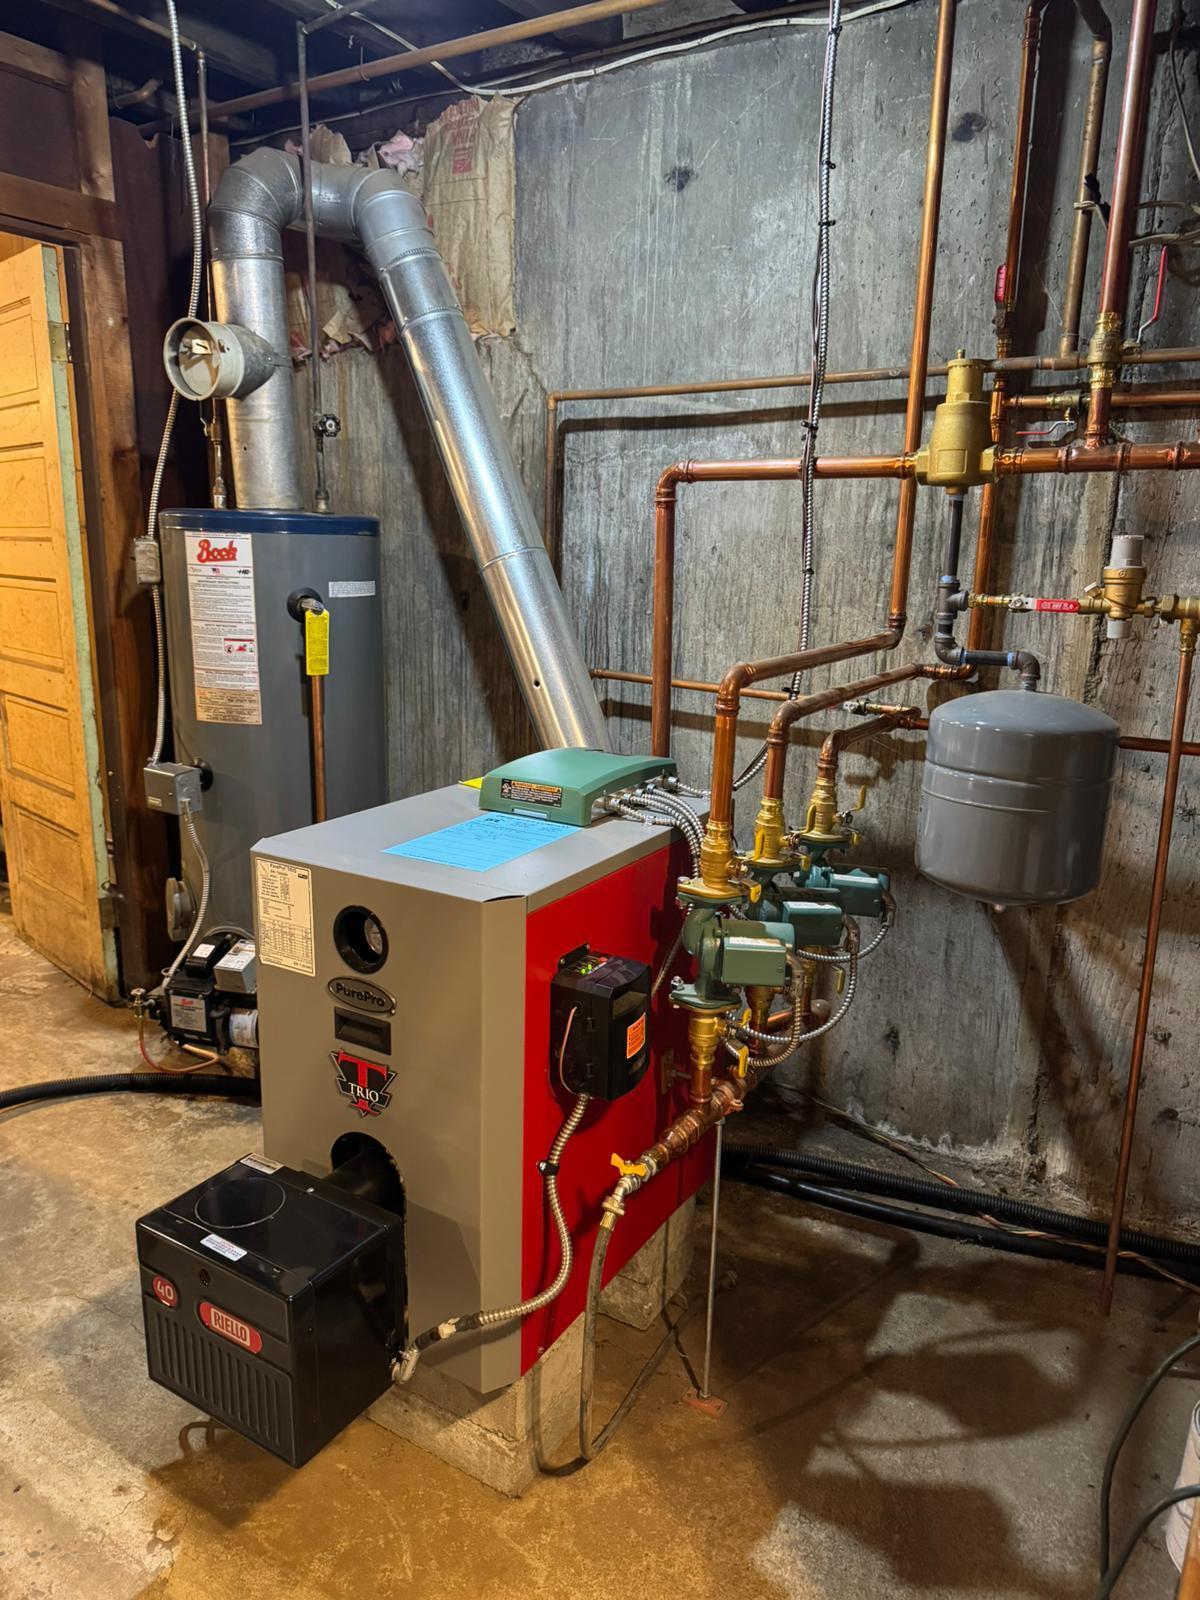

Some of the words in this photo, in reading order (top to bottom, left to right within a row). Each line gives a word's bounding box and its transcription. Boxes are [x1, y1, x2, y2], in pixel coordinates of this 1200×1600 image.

[336, 982, 385, 1007] PurePro
[348, 1082, 379, 1103] TRIO
[157, 1281, 174, 1300] 40
[213, 1311, 248, 1342] RIELLO
